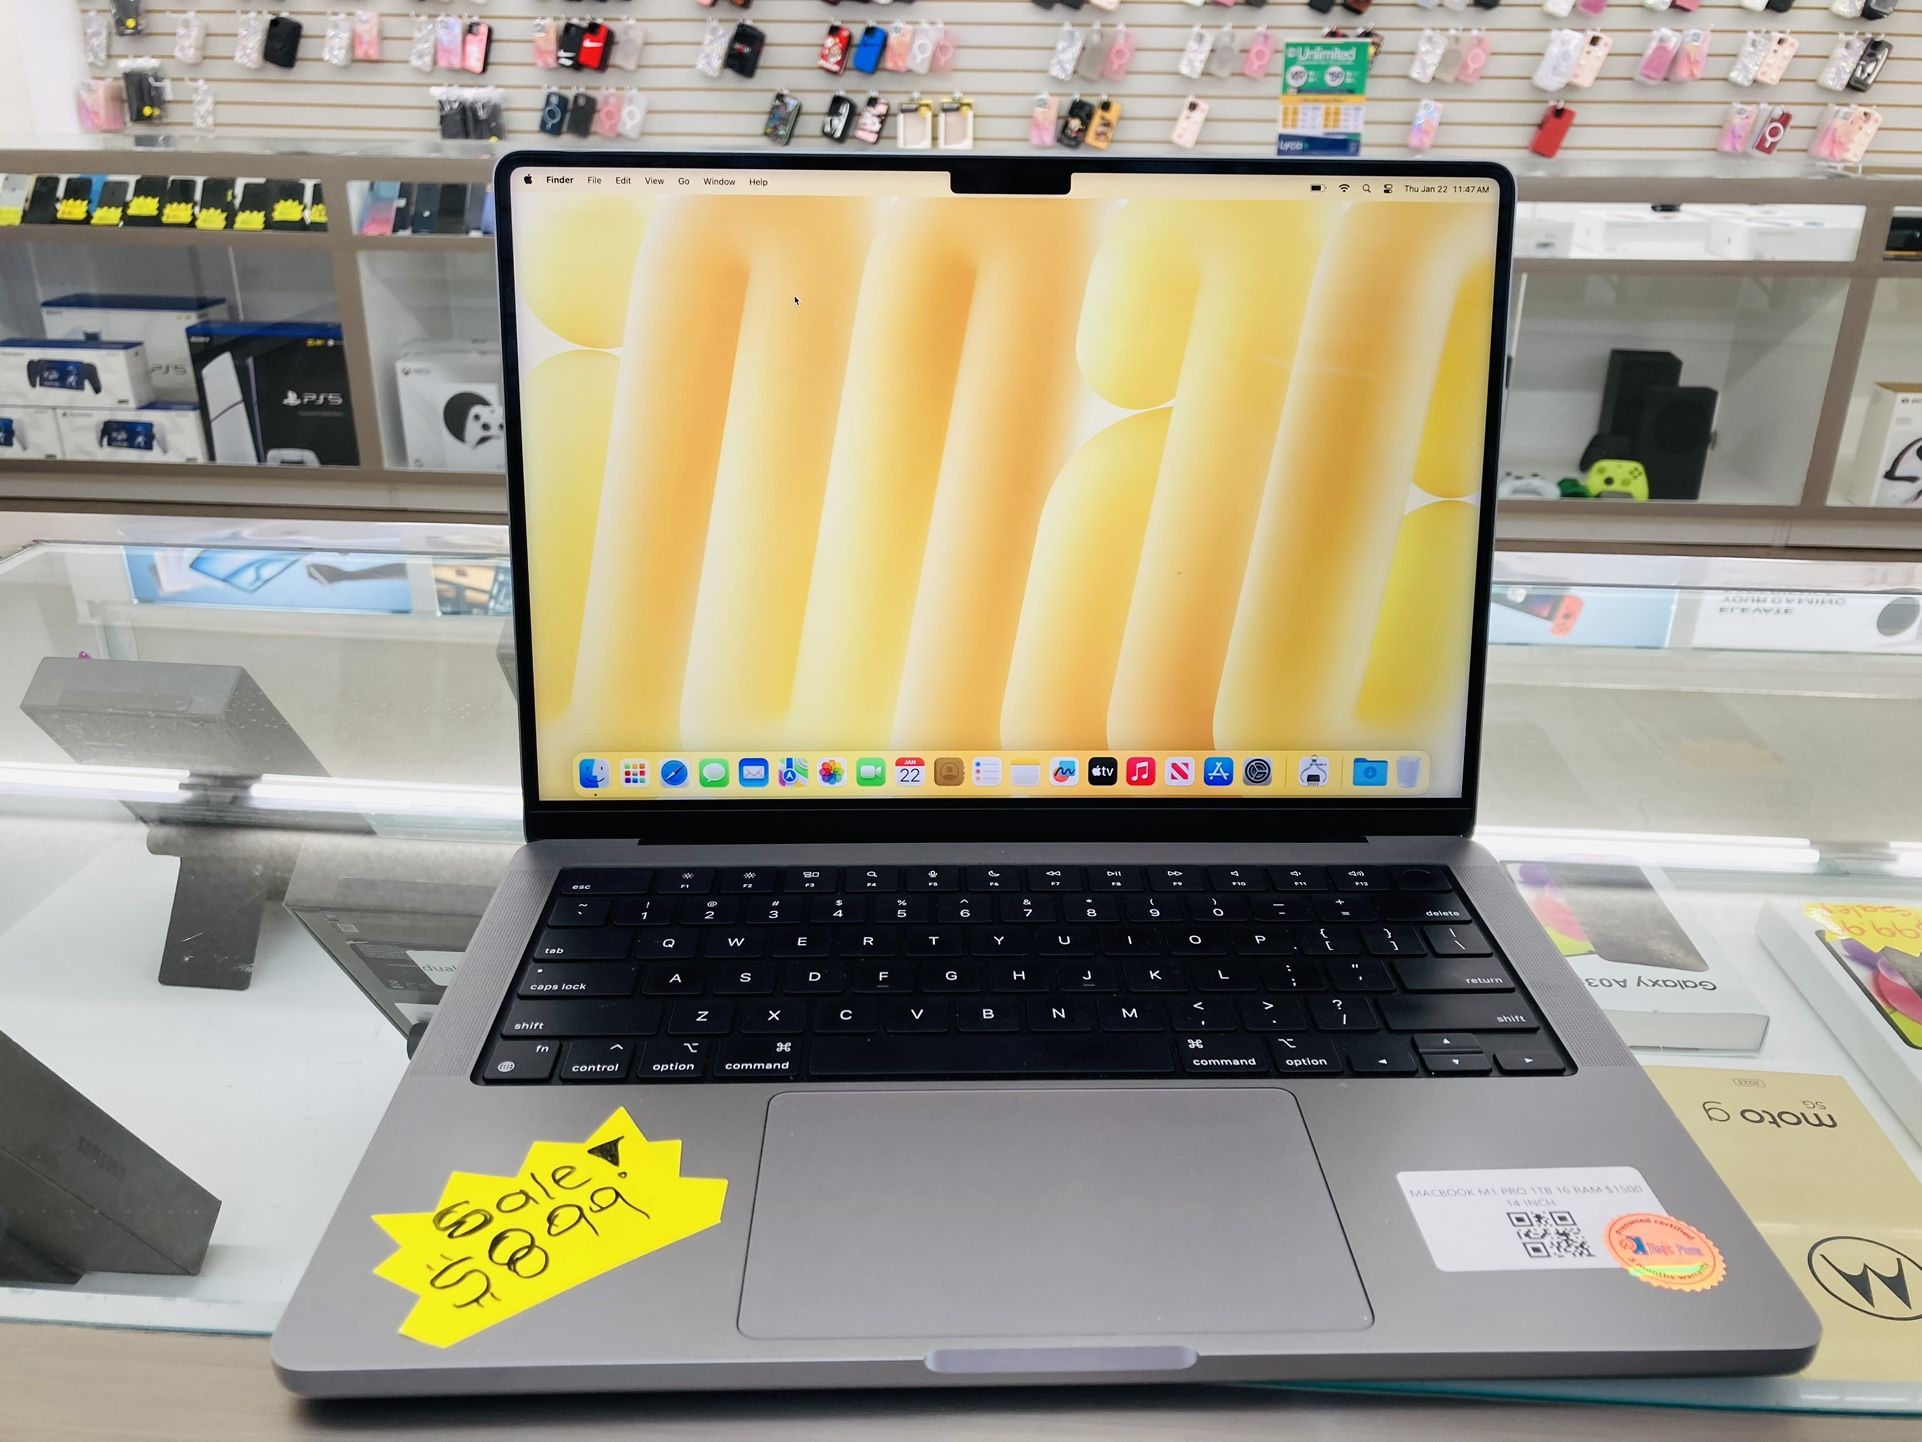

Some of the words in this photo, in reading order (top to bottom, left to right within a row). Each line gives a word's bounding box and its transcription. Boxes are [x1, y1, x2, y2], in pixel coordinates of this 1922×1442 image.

[1300, 46, 1356, 60] Unlimited
[546, 176, 574, 184] Finder
[587, 176, 602, 185] File
[615, 176, 632, 185] Edit
[644, 176, 664, 185] View
[678, 178, 690, 186] Go
[703, 178, 736, 186] Window
[750, 178, 768, 188] Help
[1404, 184, 1418, 192] Thu
[1420, 185, 1436, 193] Jan
[152, 364, 188, 376] PS5
[302, 392, 344, 406] PS5
[900, 768, 920, 783] 22
[1102, 766, 1114, 776] tv
[642, 912, 648, 920] 1
[704, 910, 714, 920] 2
[768, 910, 778, 918] 3
[832, 910, 844, 918] 4
[896, 910, 906, 918] 5
[960, 908, 970, 918] 6
[1024, 908, 1032, 918] 7
[1086, 908, 1098, 918] 8
[1150, 908, 1160, 918] 9
[662, 938, 676, 948] Q
[728, 938, 744, 946] W
[798, 936, 808, 946] E
[862, 936, 874, 946] R
[928, 936, 940, 946] T
[994, 936, 1004, 946] Y
[1058, 936, 1070, 946] U
[1254, 936, 1266, 944] P
[530, 983, 560, 992] caps
[668, 974, 682, 984] A
[740, 972, 752, 982] S
[808, 972, 822, 982] D
[878, 972, 888, 982] F
[946, 970, 958, 980] G
[1012, 970, 1026, 980] H
[1082, 970, 1092, 980] J
[1148, 970, 1162, 980] K
[1218, 970, 1230, 980] L
[1584, 977, 1628, 988] A03
[1636, 976, 1717, 990] Galaxy
[514, 1022, 544, 1030] shift
[696, 1010, 708, 1022] Z
[768, 1010, 780, 1020] X
[840, 1010, 852, 1020] C
[910, 1008, 924, 1020] V
[982, 1008, 994, 1020] B
[1052, 1008, 1066, 1018] N
[1122, 1008, 1138, 1018] M
[1496, 1014, 1526, 1022] shift
[536, 1044, 550, 1052] fn
[572, 1064, 620, 1072] control
[652, 1062, 694, 1072] option
[724, 1060, 790, 1070] command
[1192, 1058, 1256, 1066] command
[1286, 1056, 1328, 1066] option
[1702, 1100, 1731, 1122] g
[1802, 1100, 1827, 1110] 5G
[1740, 1108, 1838, 1128] moto
[76, 1136, 128, 1183] SAMSUNG
[432, 1135, 627, 1239] Sale!
[1409, 1188, 1475, 1198] MACBOOK
[1478, 1188, 1497, 1196] M1
[1500, 1187, 1528, 1196] PRO
[1531, 1186, 1552, 1196] 1TB
[1556, 1186, 1572, 1195] 16
[1574, 1185, 1603, 1194] RAM
[1605, 1184, 1644, 1194] $1500
